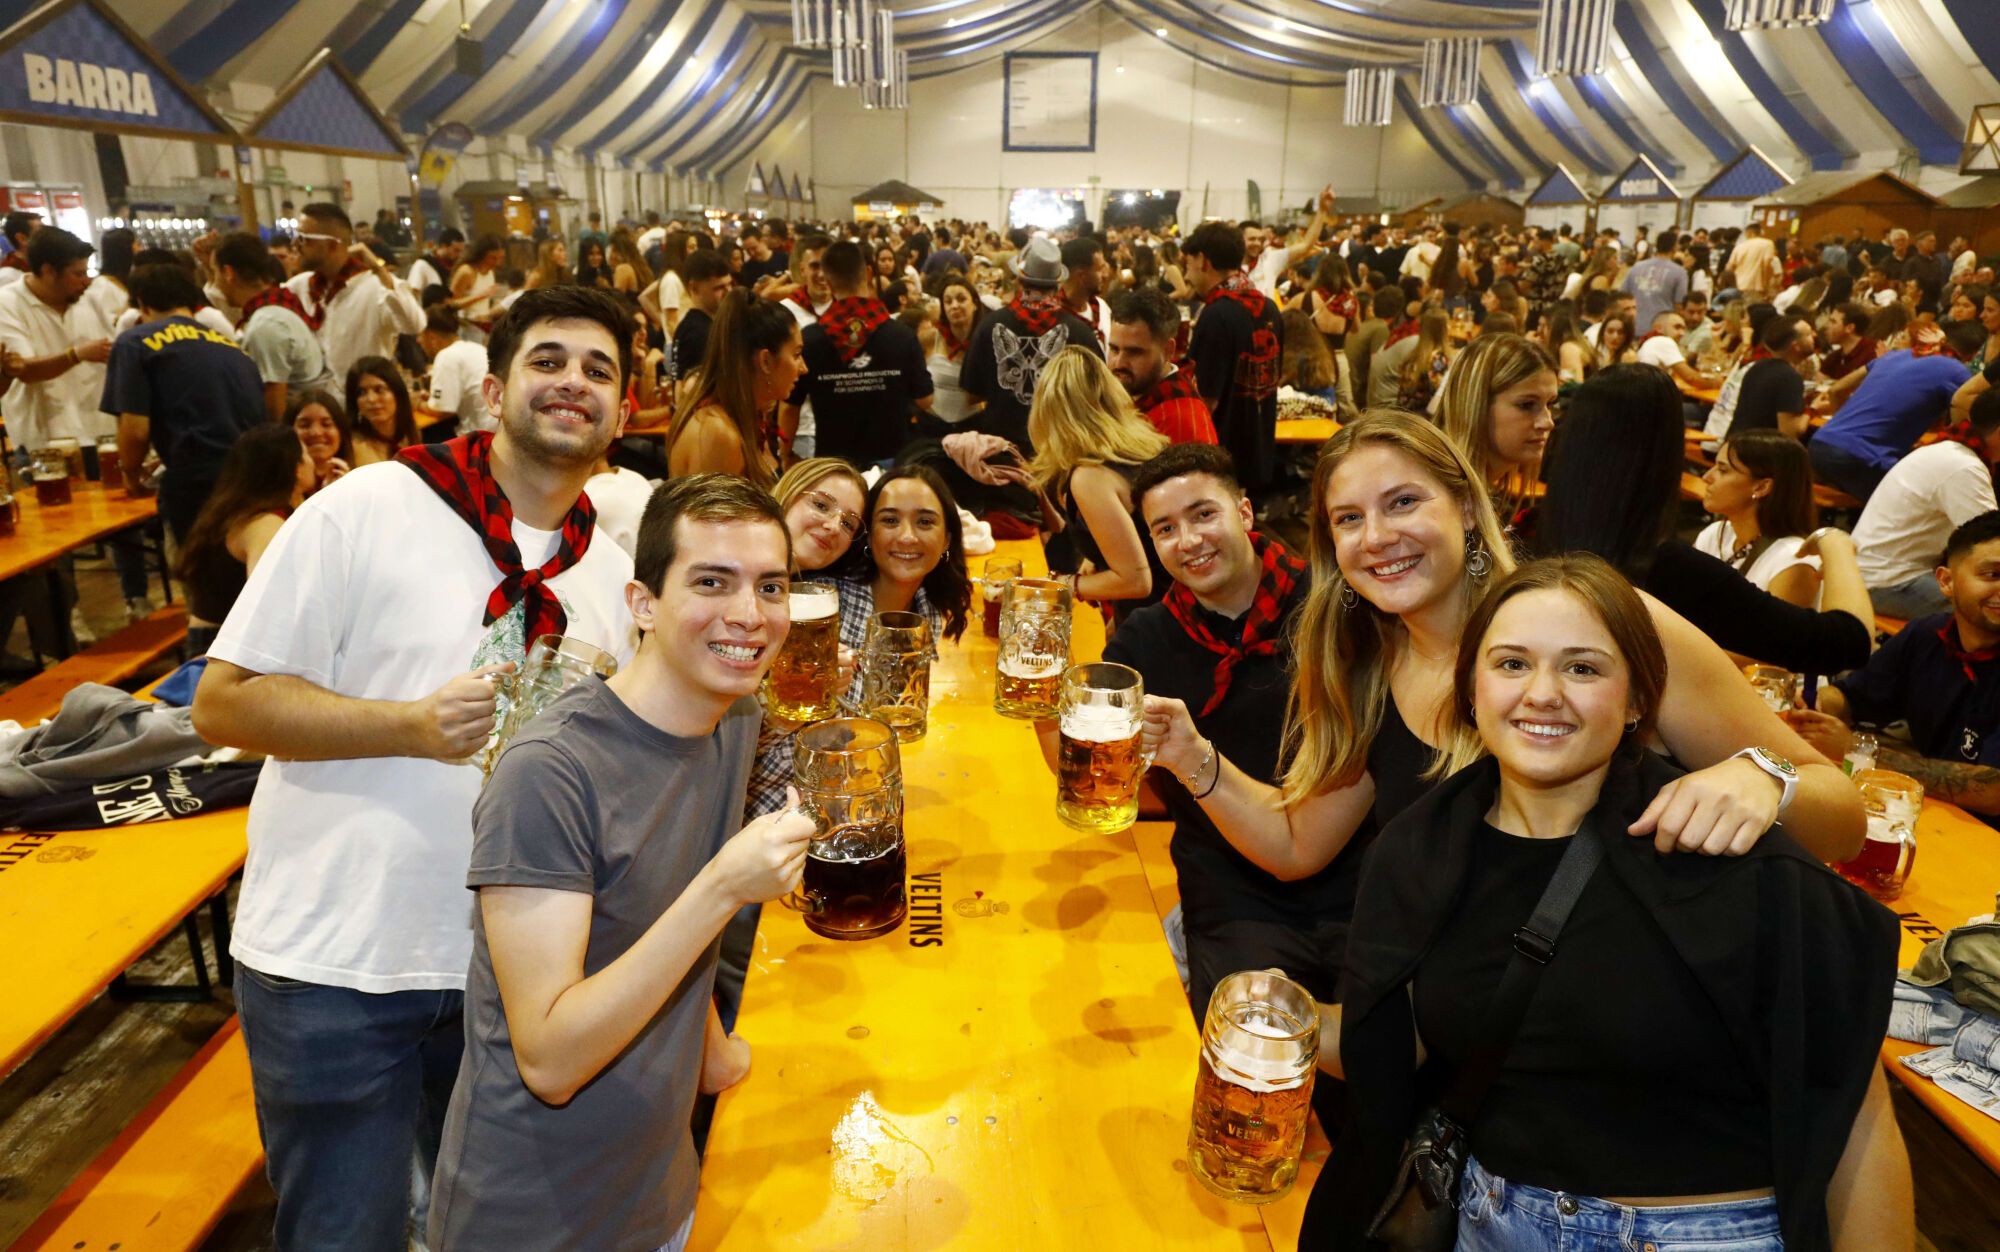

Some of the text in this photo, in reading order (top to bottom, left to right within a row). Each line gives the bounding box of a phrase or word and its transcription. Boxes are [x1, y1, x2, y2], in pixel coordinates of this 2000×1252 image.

[23, 53, 158, 116] BARRA
[1021, 657, 1053, 667] VELTINS
[909, 873, 943, 947] VELTINS
